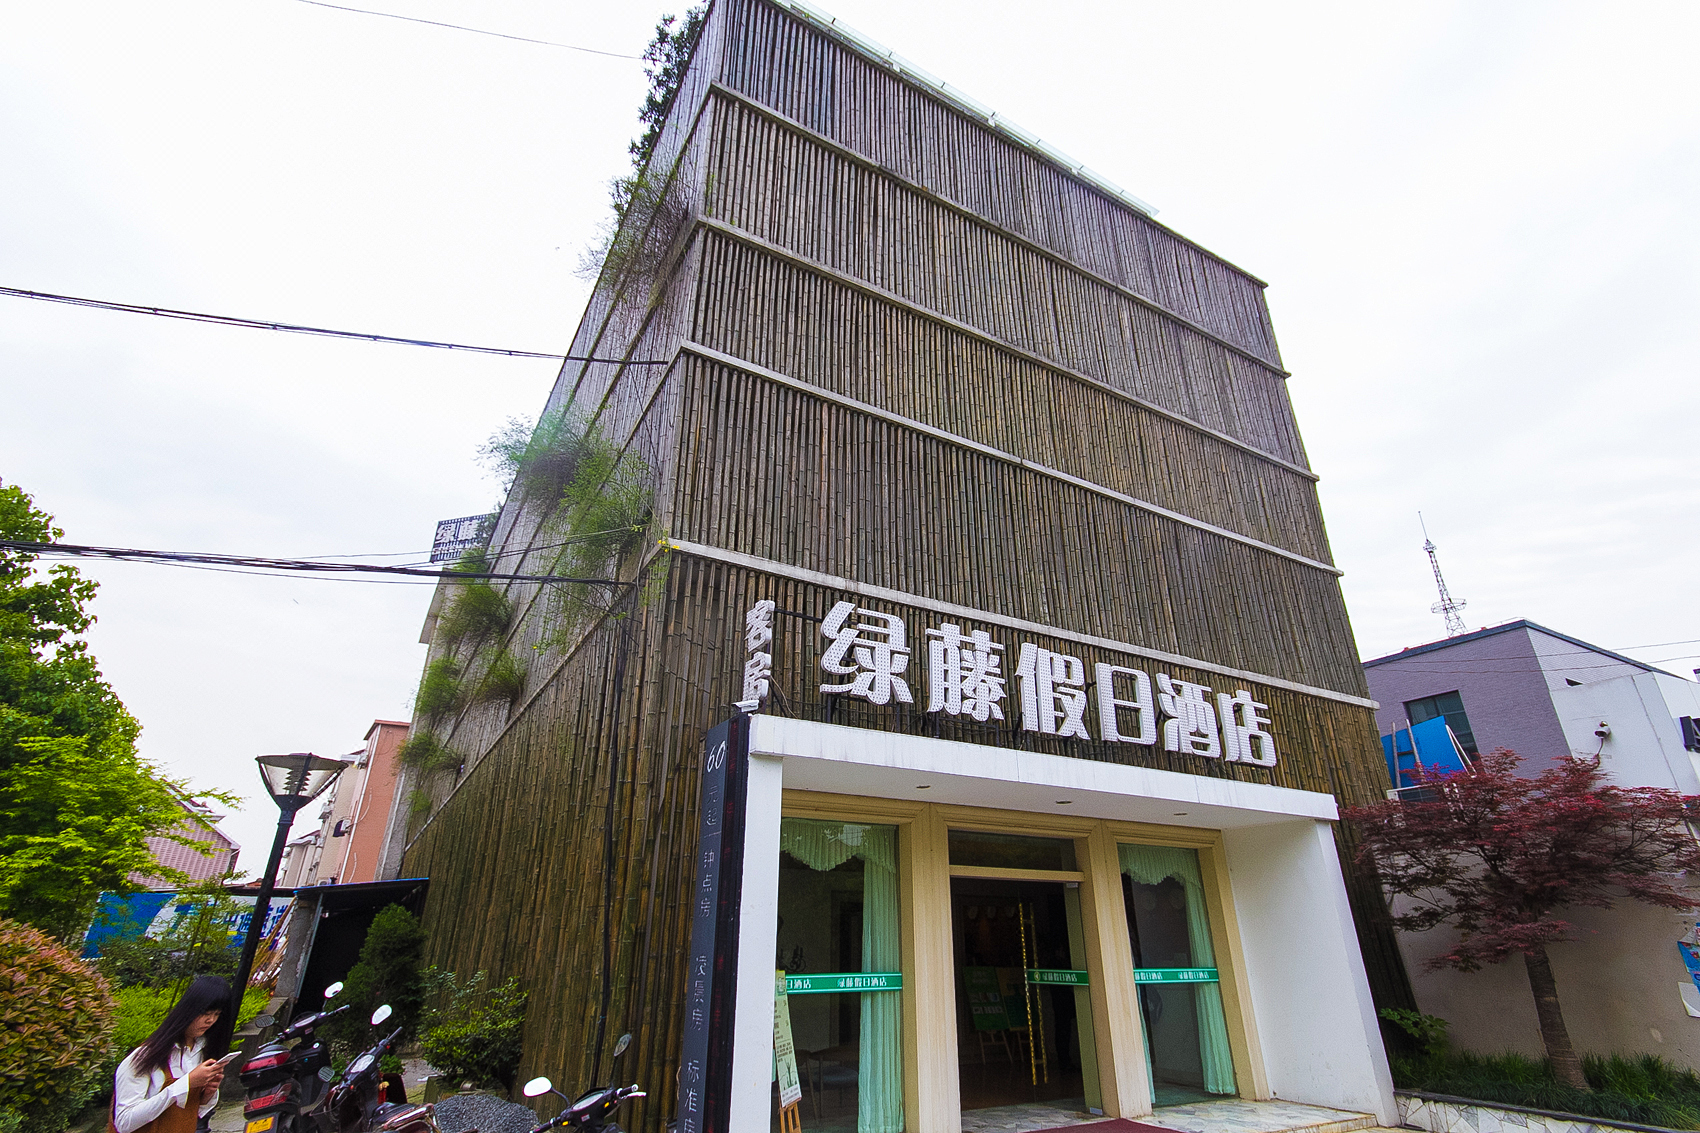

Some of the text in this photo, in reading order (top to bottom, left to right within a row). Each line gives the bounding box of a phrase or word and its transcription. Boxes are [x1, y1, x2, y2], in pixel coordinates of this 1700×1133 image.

[742, 599, 775, 702] 客房
[819, 601, 1277, 767] 绿藤假日酒店
